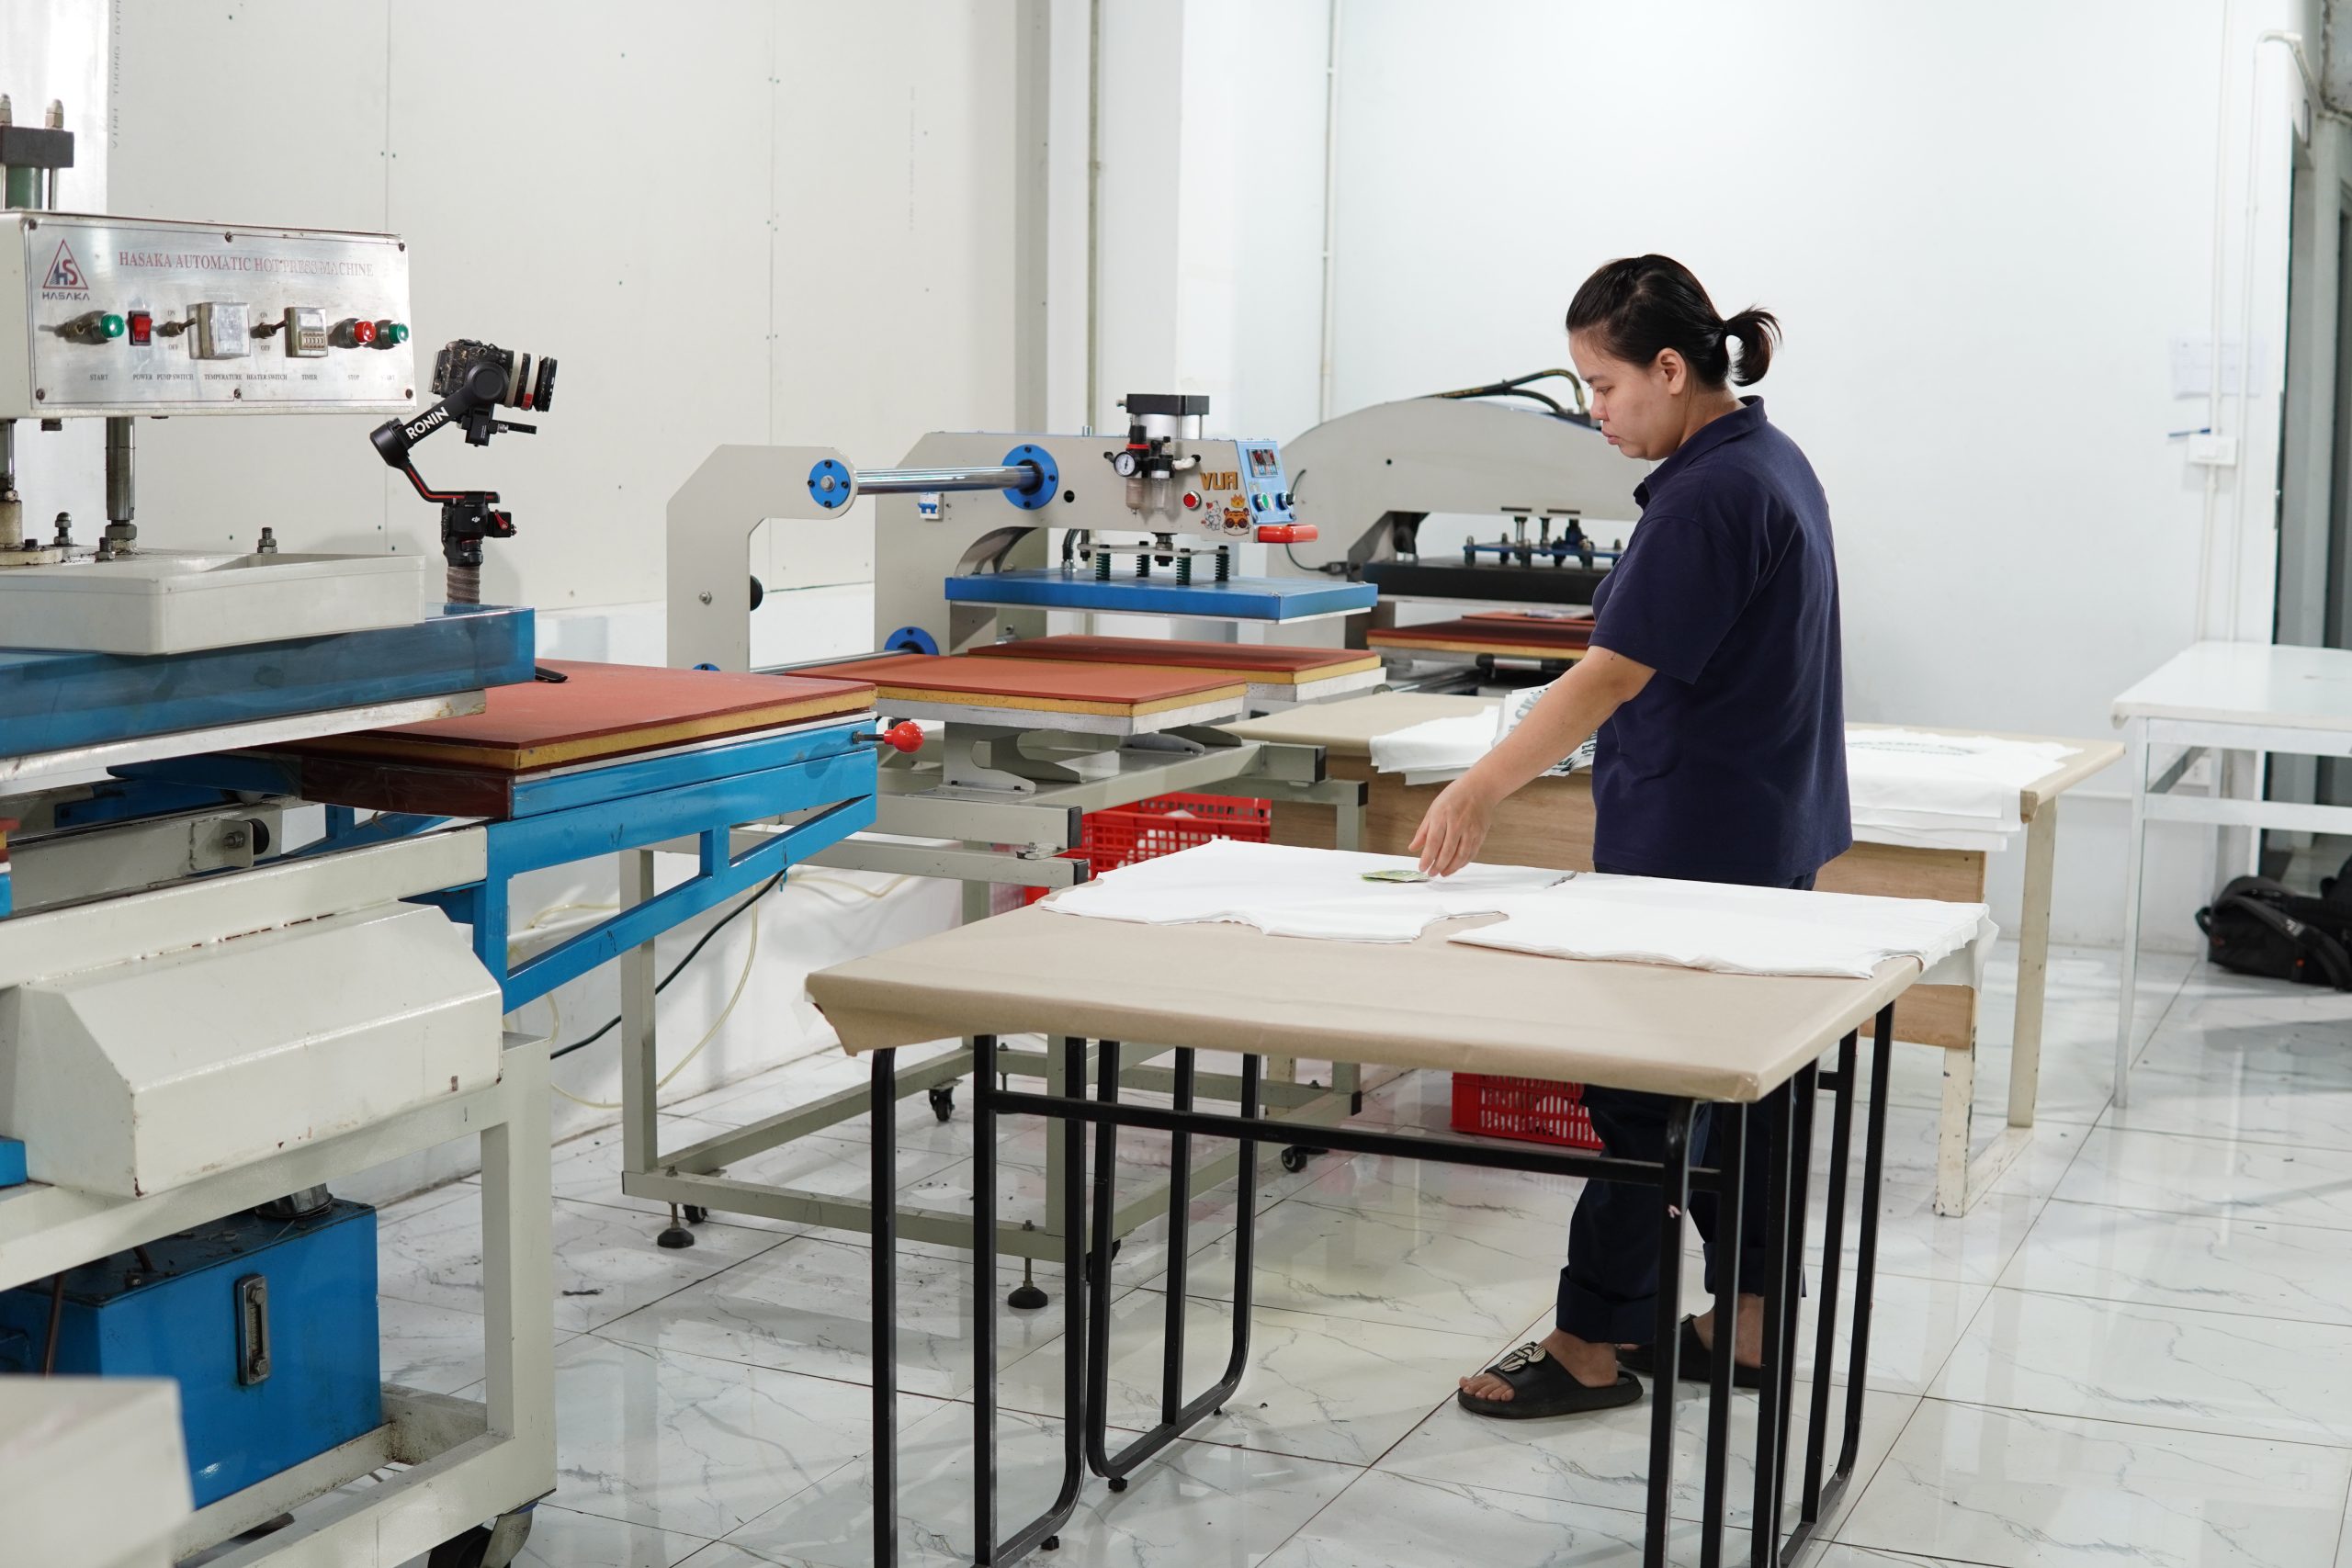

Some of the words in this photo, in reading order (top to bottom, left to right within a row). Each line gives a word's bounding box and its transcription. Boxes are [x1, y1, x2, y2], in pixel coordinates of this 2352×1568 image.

[119, 251, 172, 268] HASAKA
[175, 254, 251, 271] AUTOMATIC
[254, 257, 279, 273] HOT
[320, 261, 374, 276] MACHINE
[42, 291, 90, 301] HASAKA
[404, 406, 449, 440] RONIN
